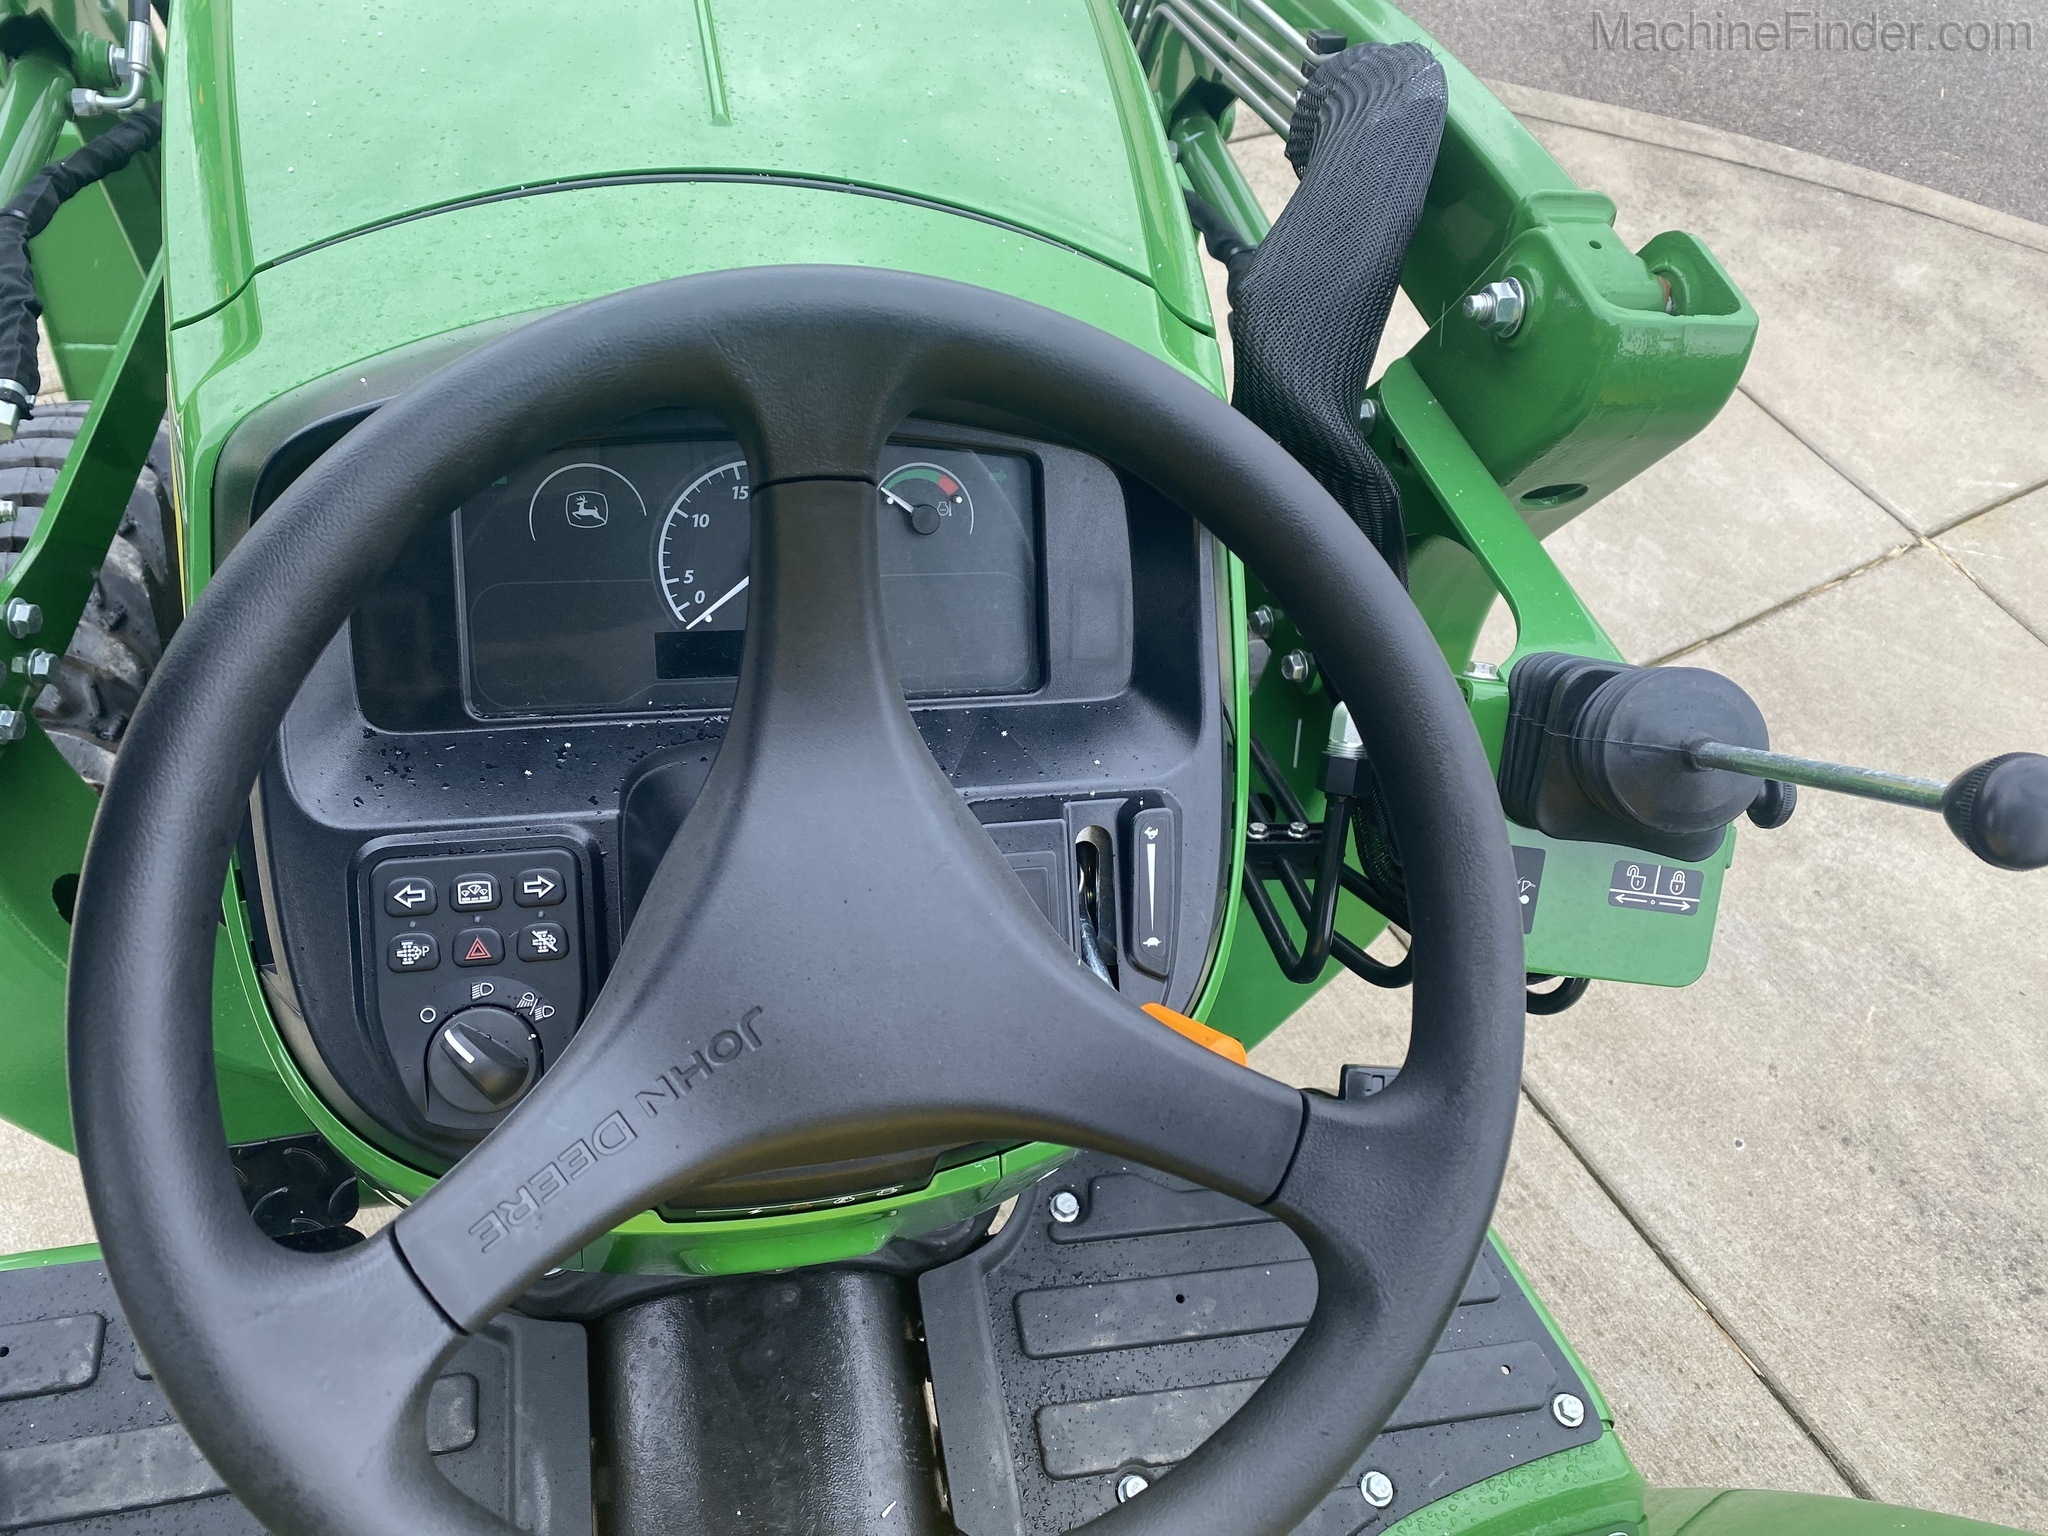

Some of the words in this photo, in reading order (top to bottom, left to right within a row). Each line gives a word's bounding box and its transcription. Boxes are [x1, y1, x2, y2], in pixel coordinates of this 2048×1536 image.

[732, 485, 749, 500] 15
[692, 513, 710, 528] 10
[683, 569, 695, 584] 5
[694, 590, 706, 604] 0
[635, 1005, 764, 1119] JOHN
[468, 1110, 638, 1253] DEERE
